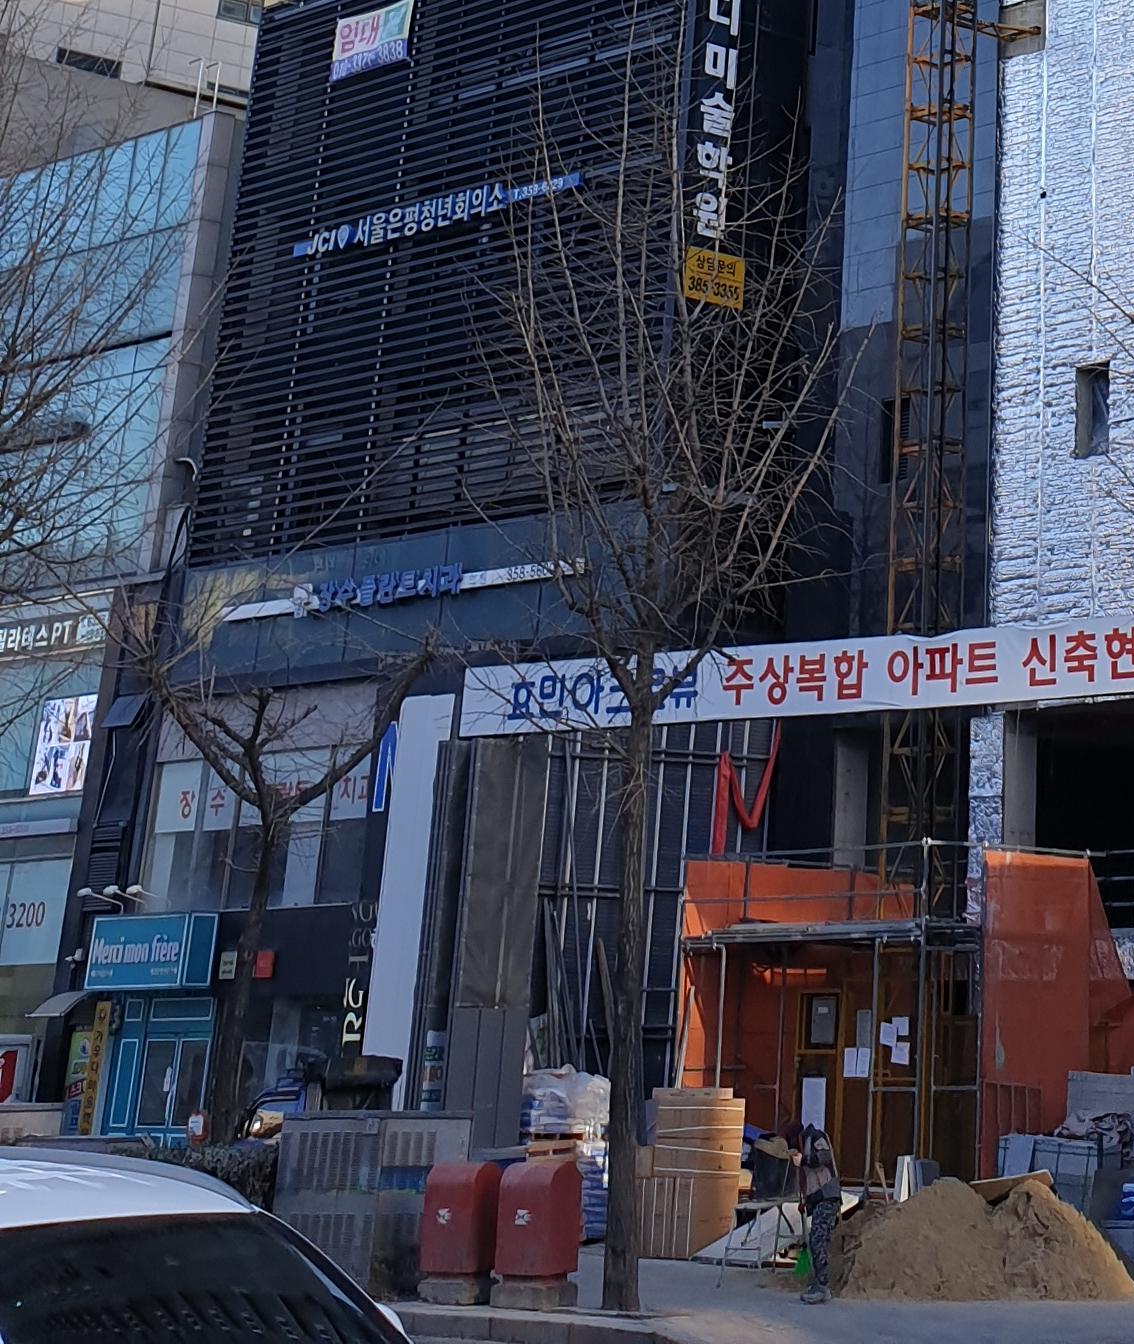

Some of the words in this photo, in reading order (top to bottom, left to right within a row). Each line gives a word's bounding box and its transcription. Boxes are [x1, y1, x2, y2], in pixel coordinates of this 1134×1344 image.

[340, 14, 380, 54] 임대
[353, 183, 506, 247] 서울은평청년회의소
[307, 228, 336, 255] JCI
[50, 620, 73, 646] PT
[722, 648, 868, 706] 주상복합
[887, 640, 998, 696] 아파트
[6, 901, 46, 929] 3200
[92, 936, 124, 965] Merci
[124, 943, 149, 965] mon
[150, 934, 180, 963] frère
